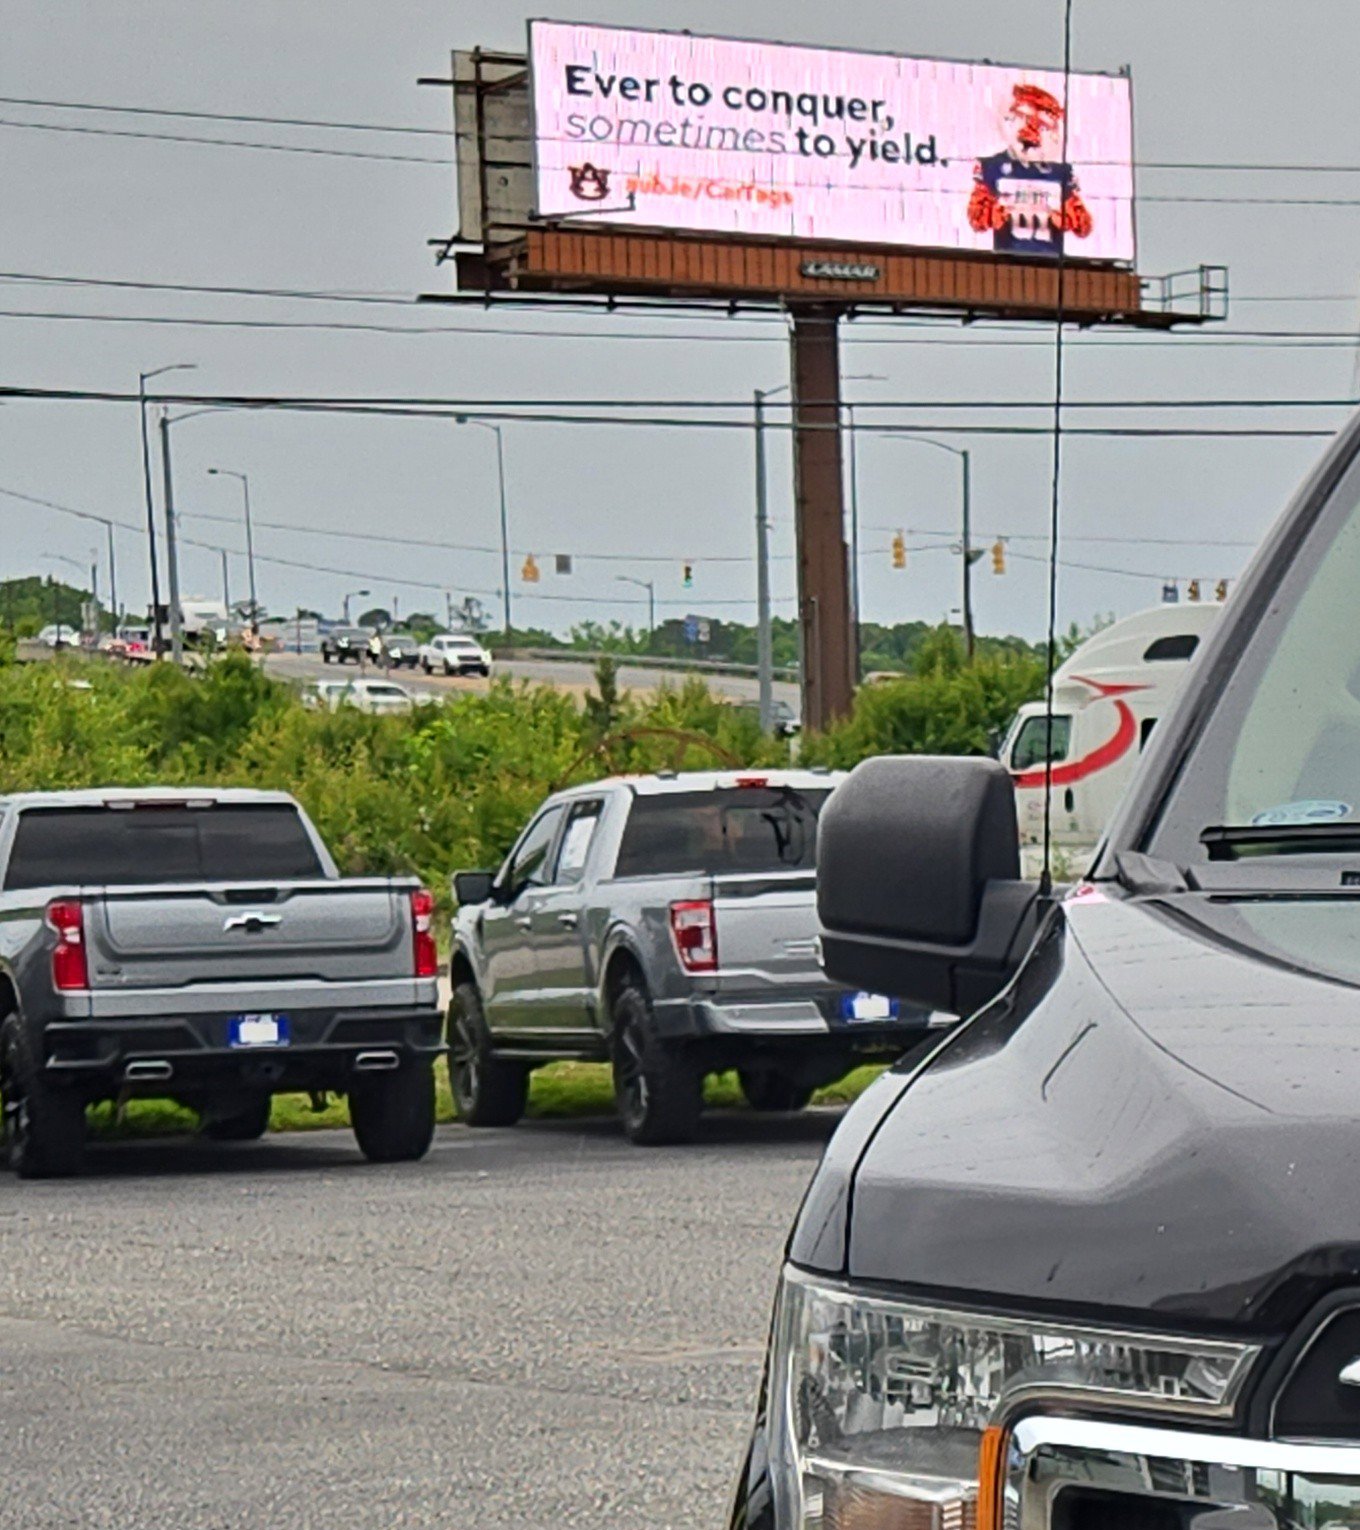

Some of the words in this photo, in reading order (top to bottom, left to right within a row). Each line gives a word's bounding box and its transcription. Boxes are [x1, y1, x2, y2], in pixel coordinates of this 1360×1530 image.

[565, 64, 660, 99] Ever
[669, 75, 712, 107] to
[722, 85, 895, 130] conquer,
[565, 112, 788, 155] sometimes
[796, 127, 836, 157] to
[846, 130, 950, 169] yield.
